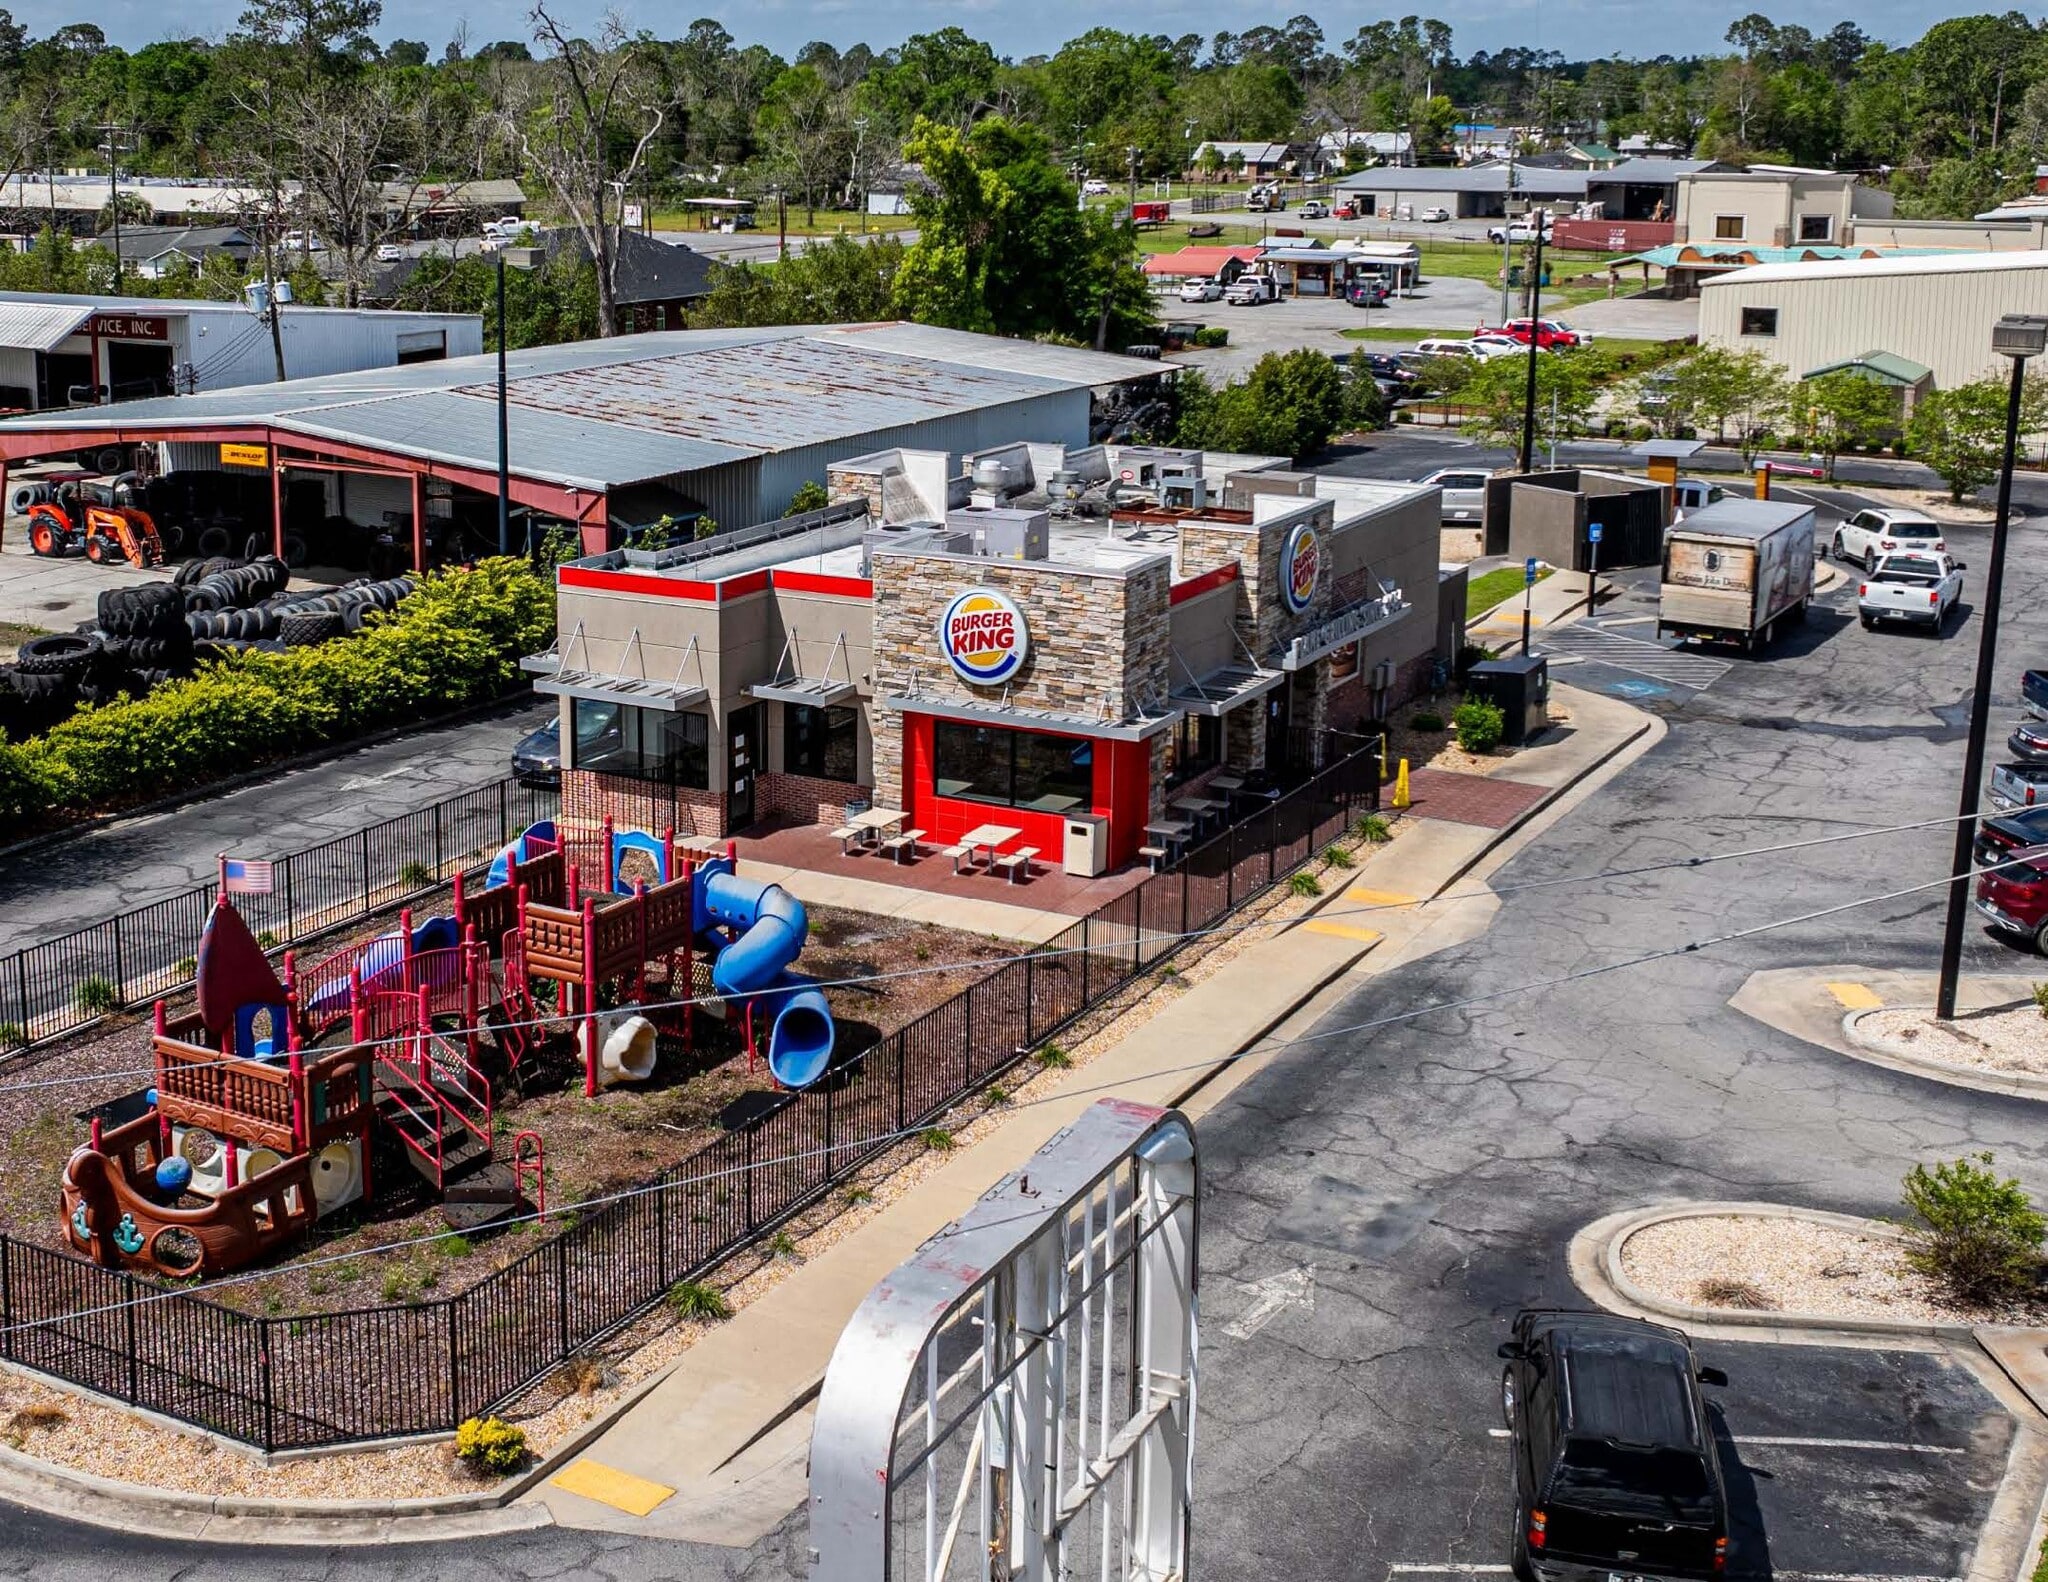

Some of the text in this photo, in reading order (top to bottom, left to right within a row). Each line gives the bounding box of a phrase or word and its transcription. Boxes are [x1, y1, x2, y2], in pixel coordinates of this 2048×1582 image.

[131, 321, 156, 335] INC.
[230, 451, 263, 459] DUNLOP
[951, 612, 1013, 634] BURGER
[953, 627, 1015, 655] KING
